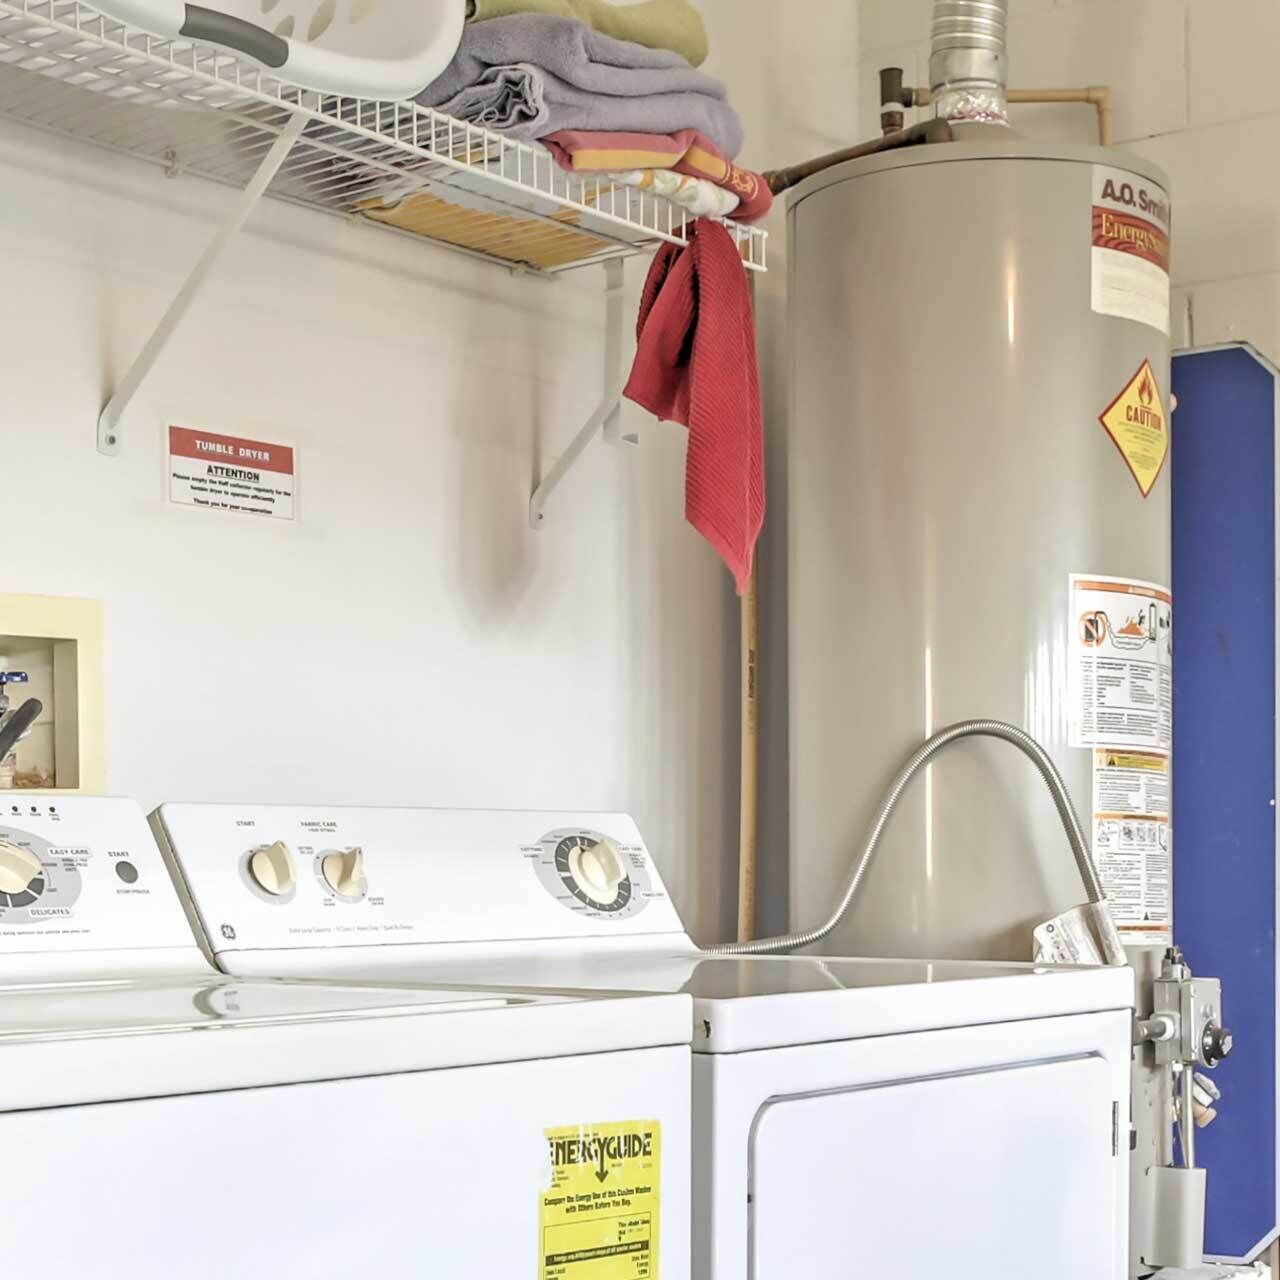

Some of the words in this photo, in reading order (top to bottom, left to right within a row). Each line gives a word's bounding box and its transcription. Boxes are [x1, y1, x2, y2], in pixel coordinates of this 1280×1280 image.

[1126, 405, 1161, 432] CAUTION
[195, 440, 234, 456] TUMBLE
[239, 447, 271, 462] DRYER
[207, 465, 259, 481] ATTENTION
